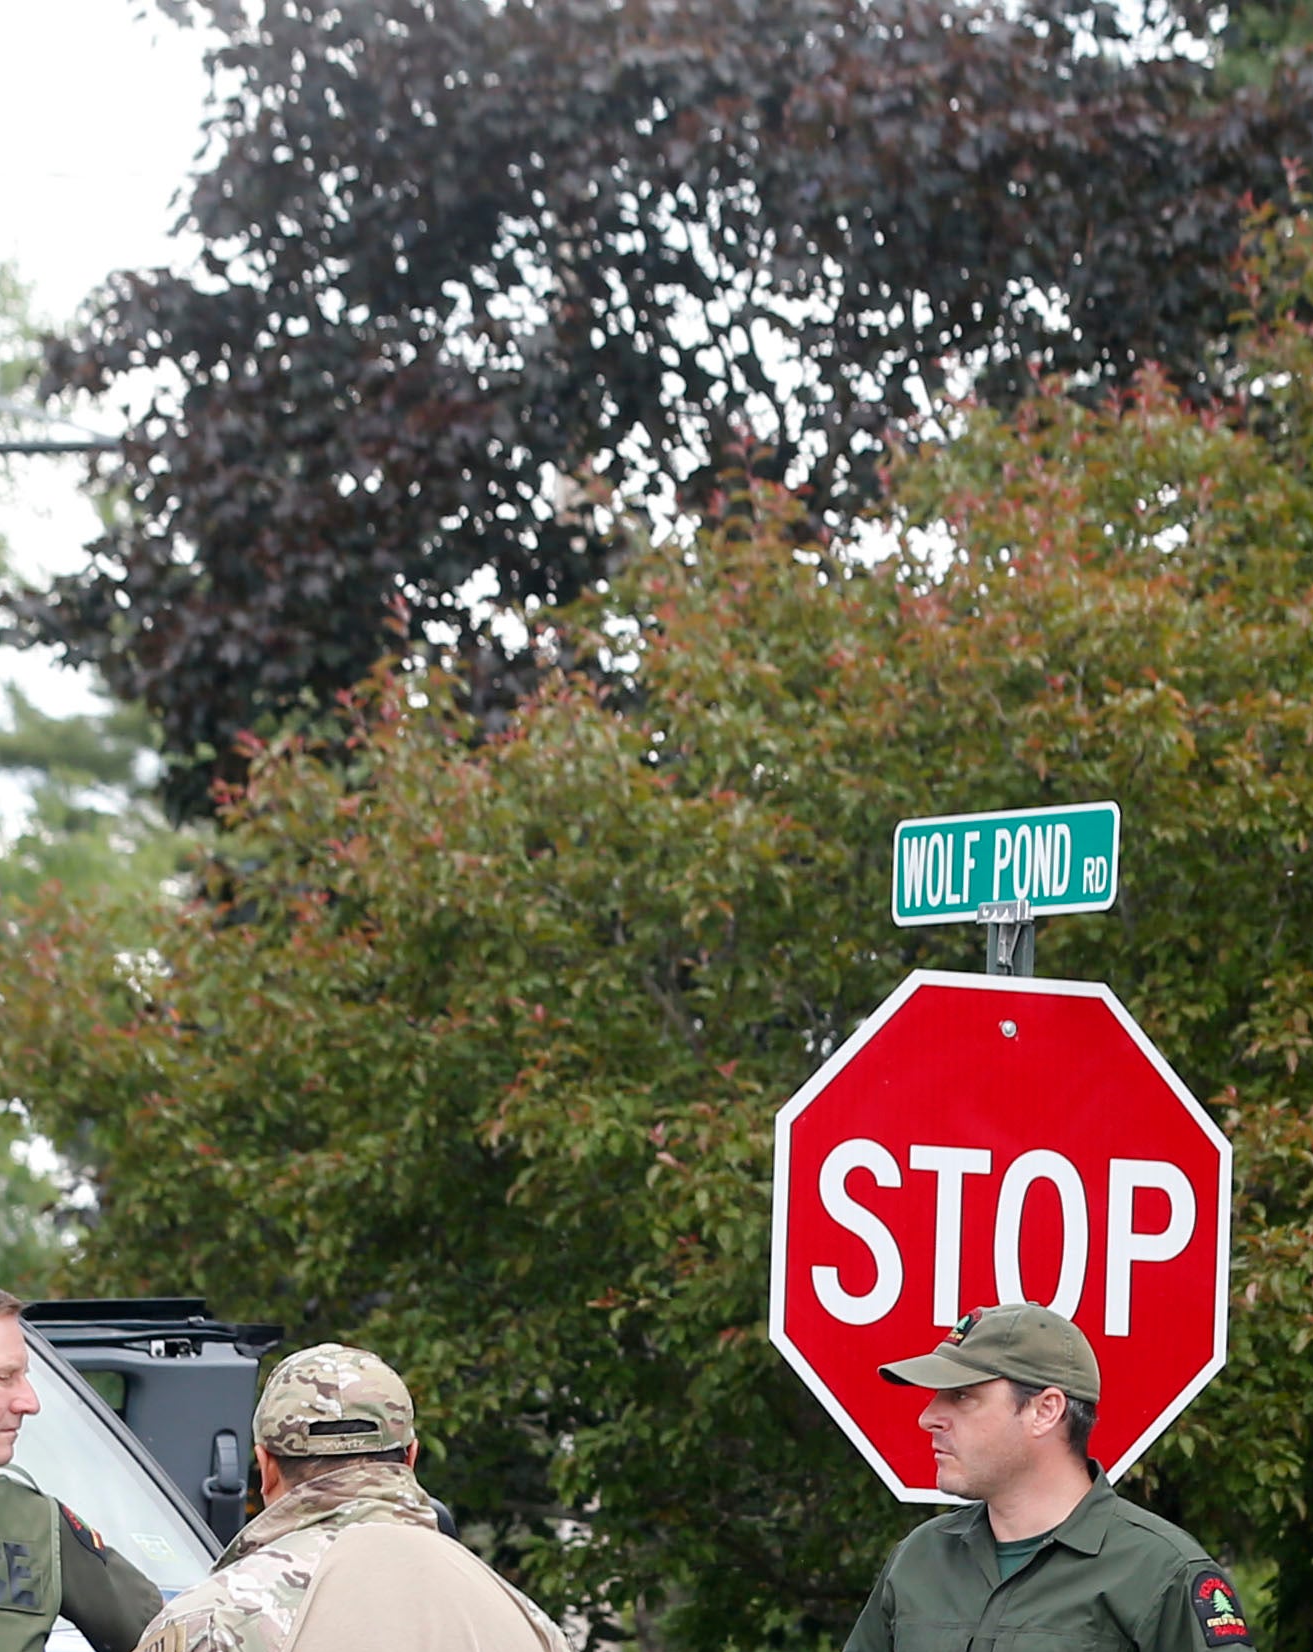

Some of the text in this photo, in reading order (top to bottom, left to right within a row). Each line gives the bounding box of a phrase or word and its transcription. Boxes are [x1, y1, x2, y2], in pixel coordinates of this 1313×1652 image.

[902, 822, 1108, 909] WOLF POND RD
[810, 1137, 1198, 1338] STOP
